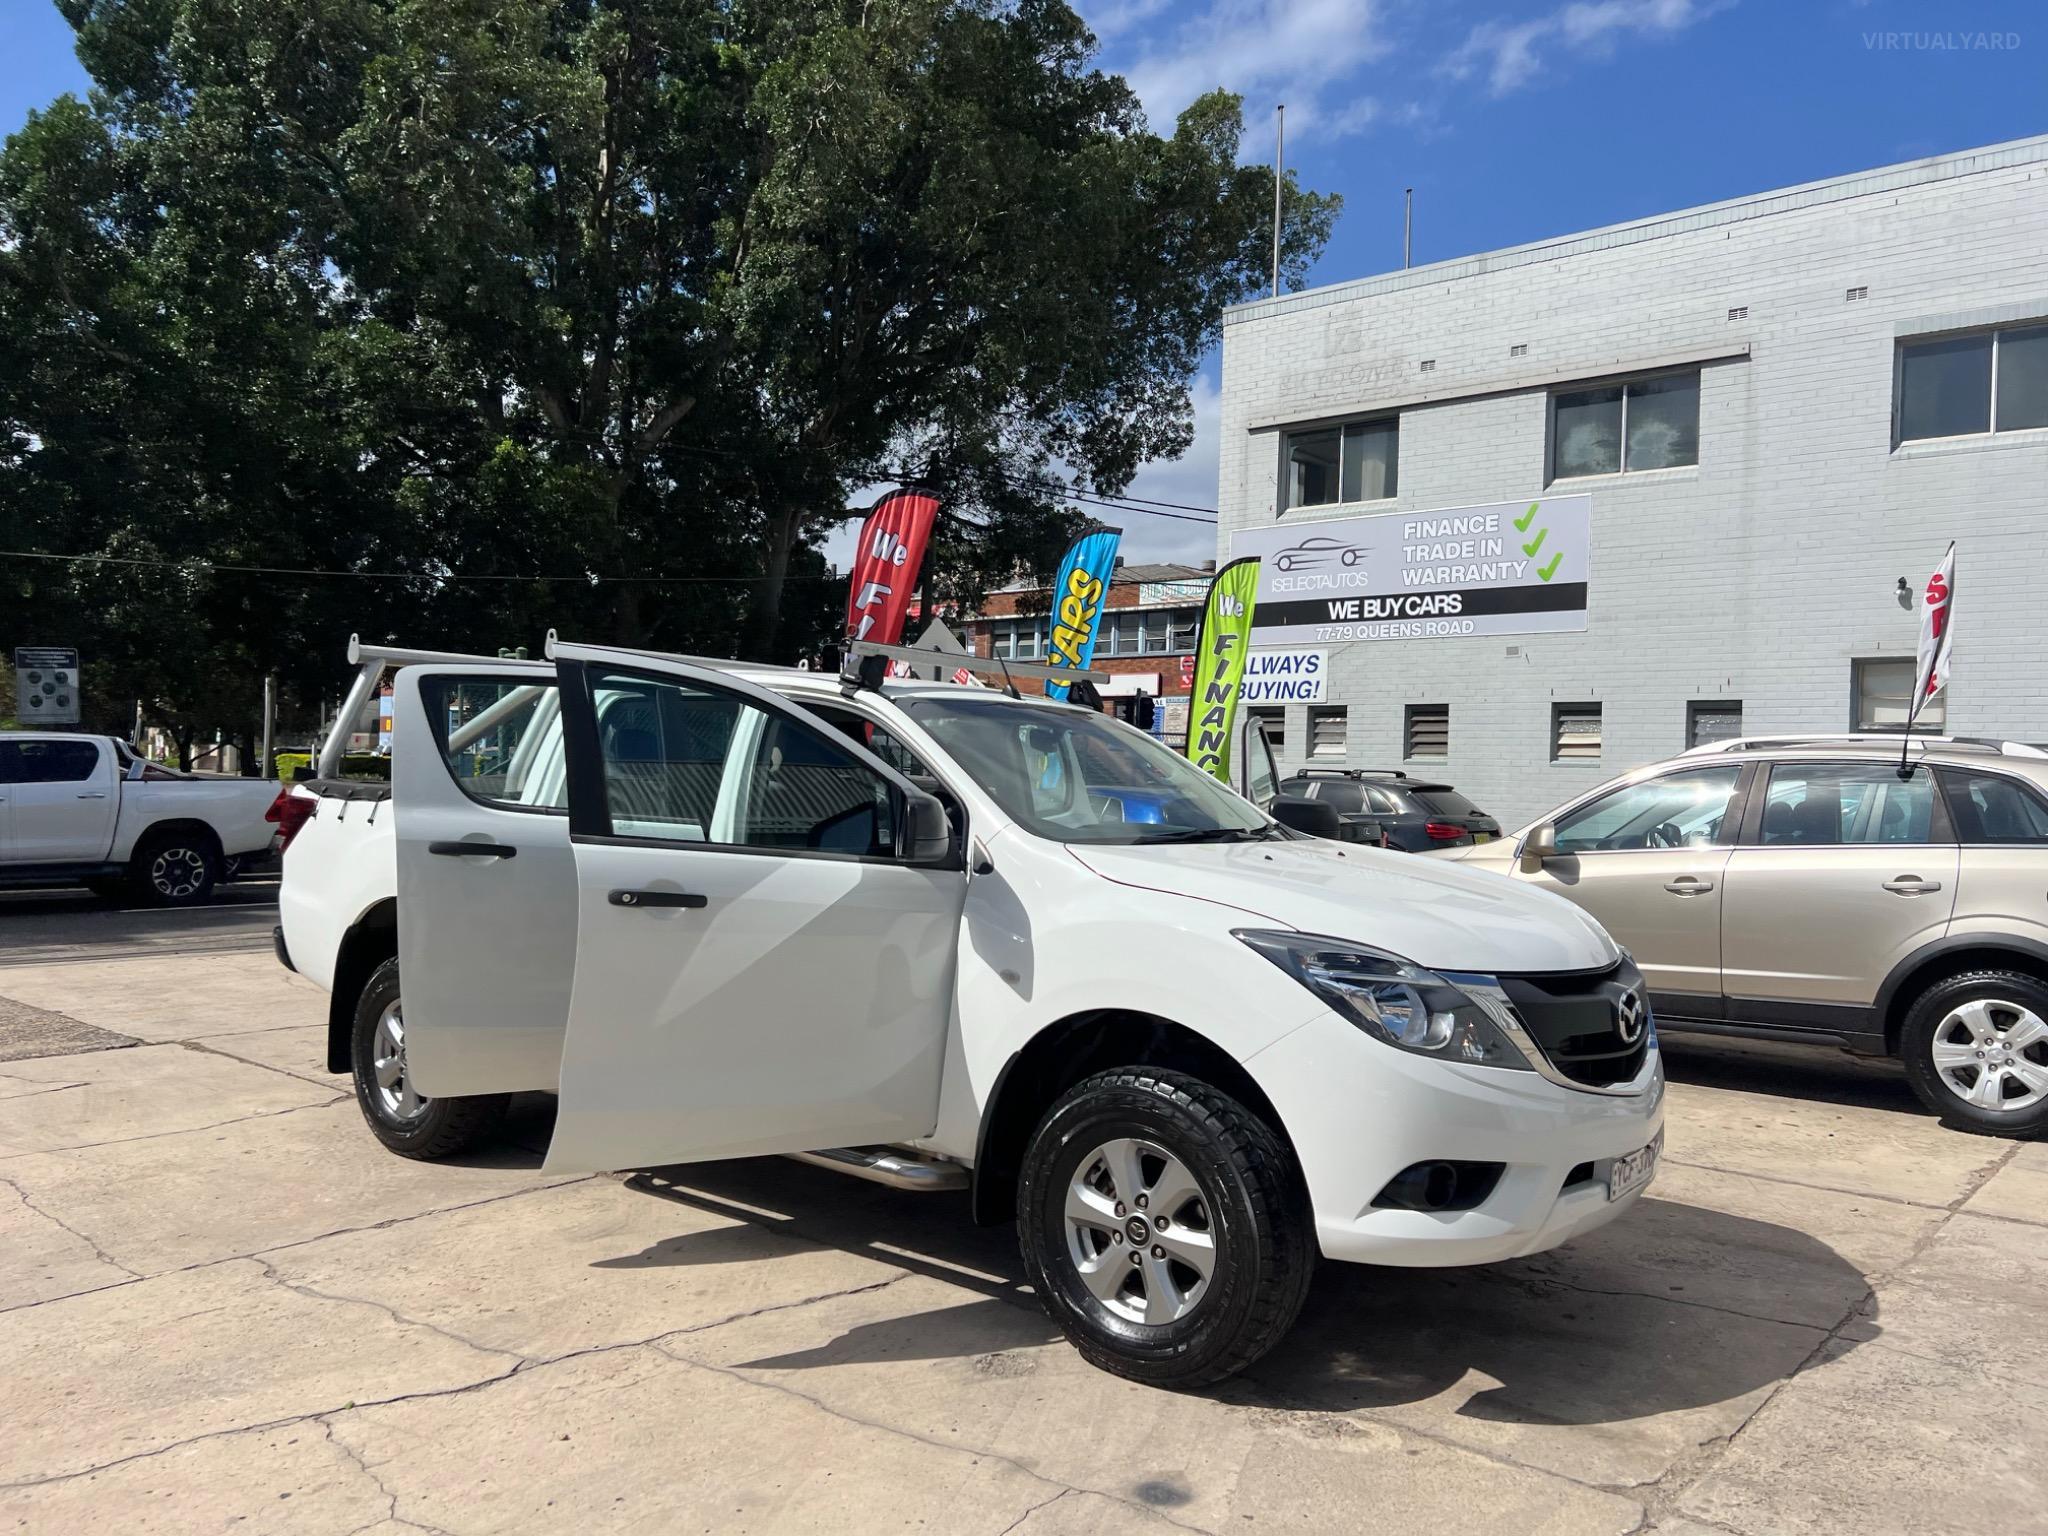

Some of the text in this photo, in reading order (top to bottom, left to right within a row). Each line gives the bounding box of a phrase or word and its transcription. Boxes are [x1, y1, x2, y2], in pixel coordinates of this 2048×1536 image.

[1403, 514, 1499, 540] FINANCE
[872, 528, 907, 567] We
[1403, 537, 1503, 563] TRADE IN
[1402, 560, 1529, 586] WARRANTY
[1219, 593, 1244, 617] We
[1328, 594, 1462, 620] WE BUY CARS
[1316, 620, 1474, 640] 77-79 QUEENS ROAD
[1243, 655, 1320, 675] LWAYS
[1238, 680, 1320, 700] BUYING!
